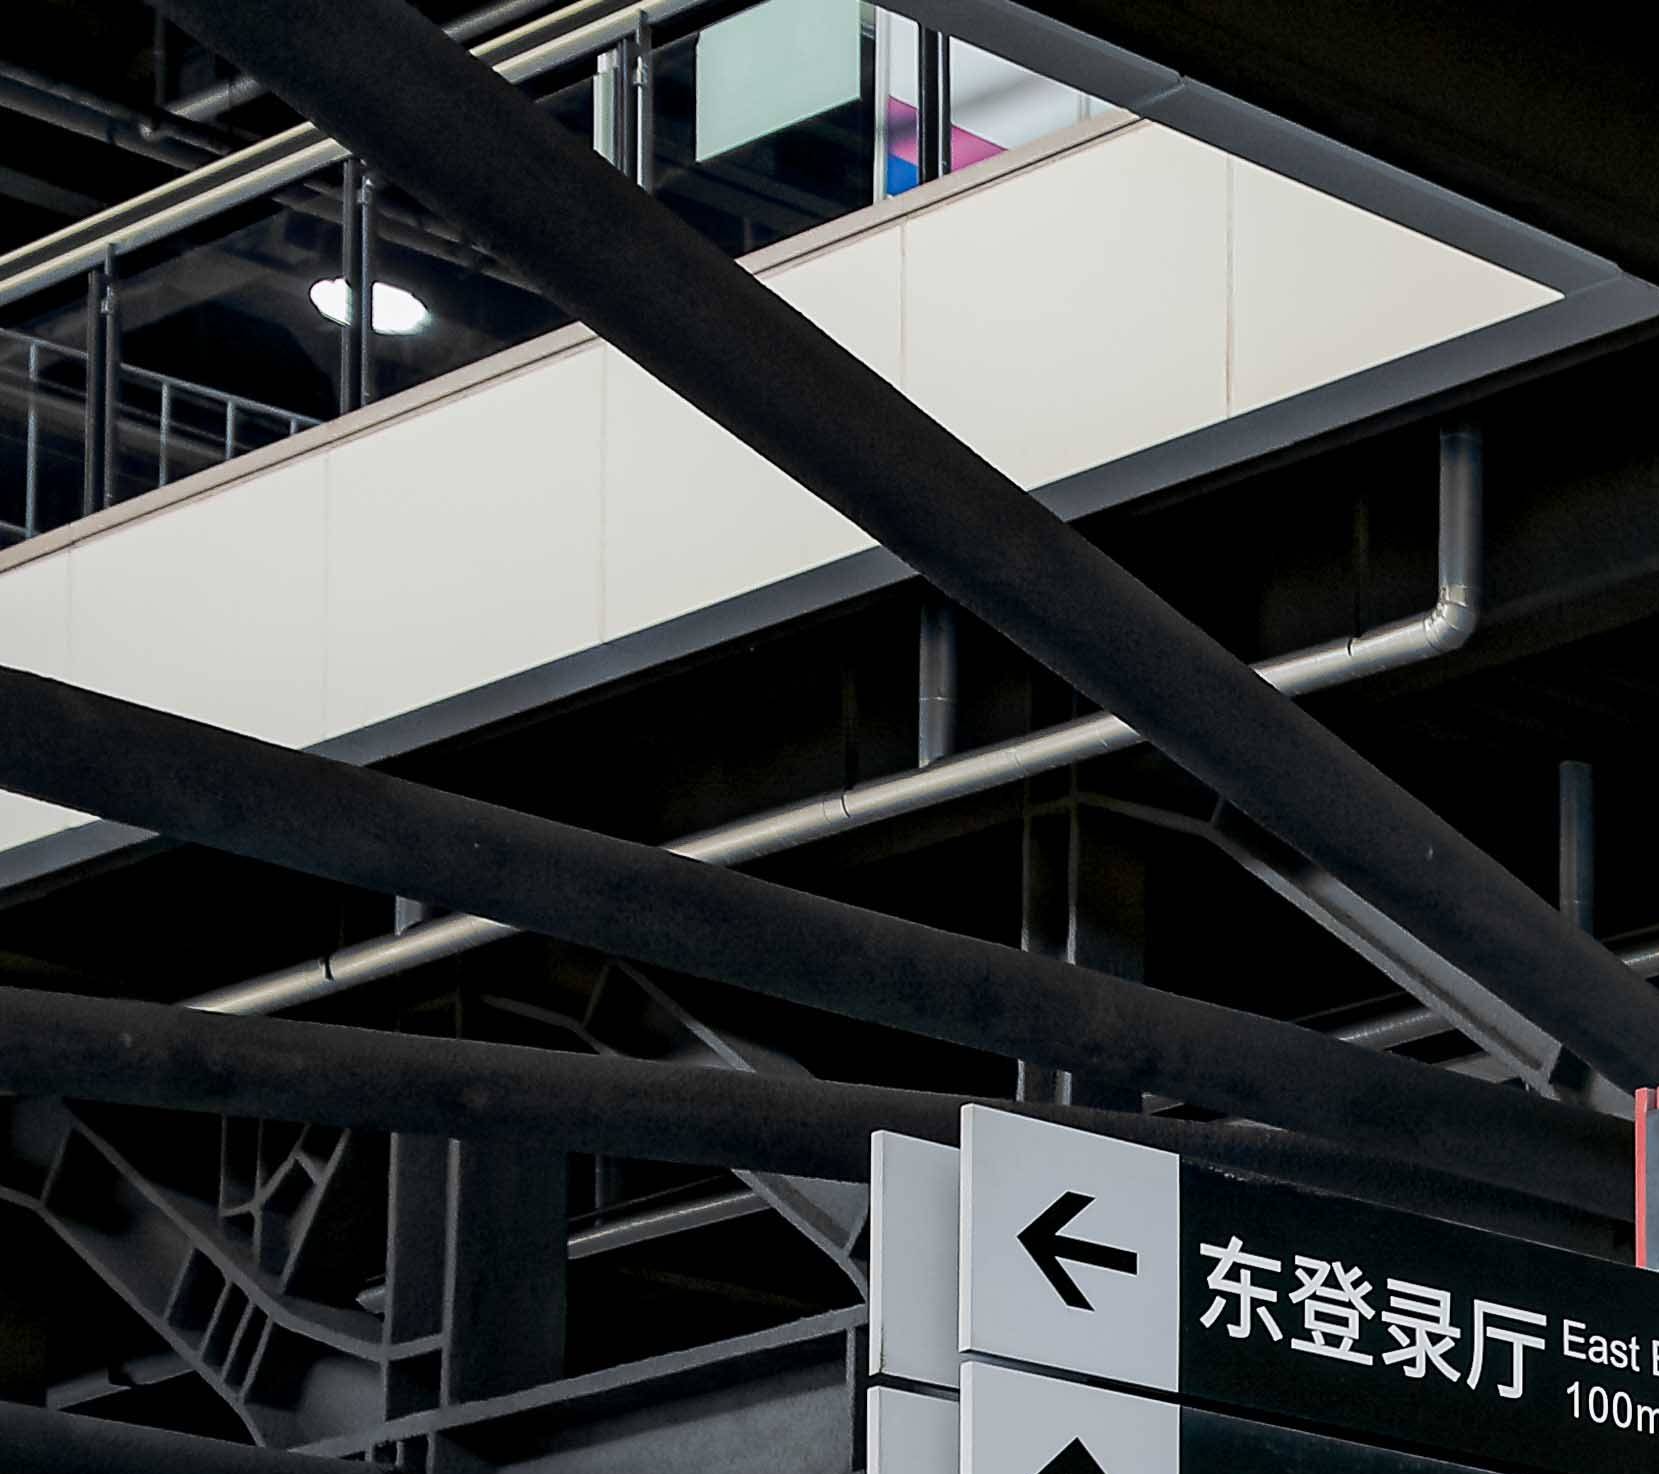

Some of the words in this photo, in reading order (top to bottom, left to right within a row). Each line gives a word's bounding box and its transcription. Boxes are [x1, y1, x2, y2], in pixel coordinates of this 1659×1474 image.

[1199, 1235, 1547, 1399] 东登录厅
[1563, 1318, 1641, 1372] East
